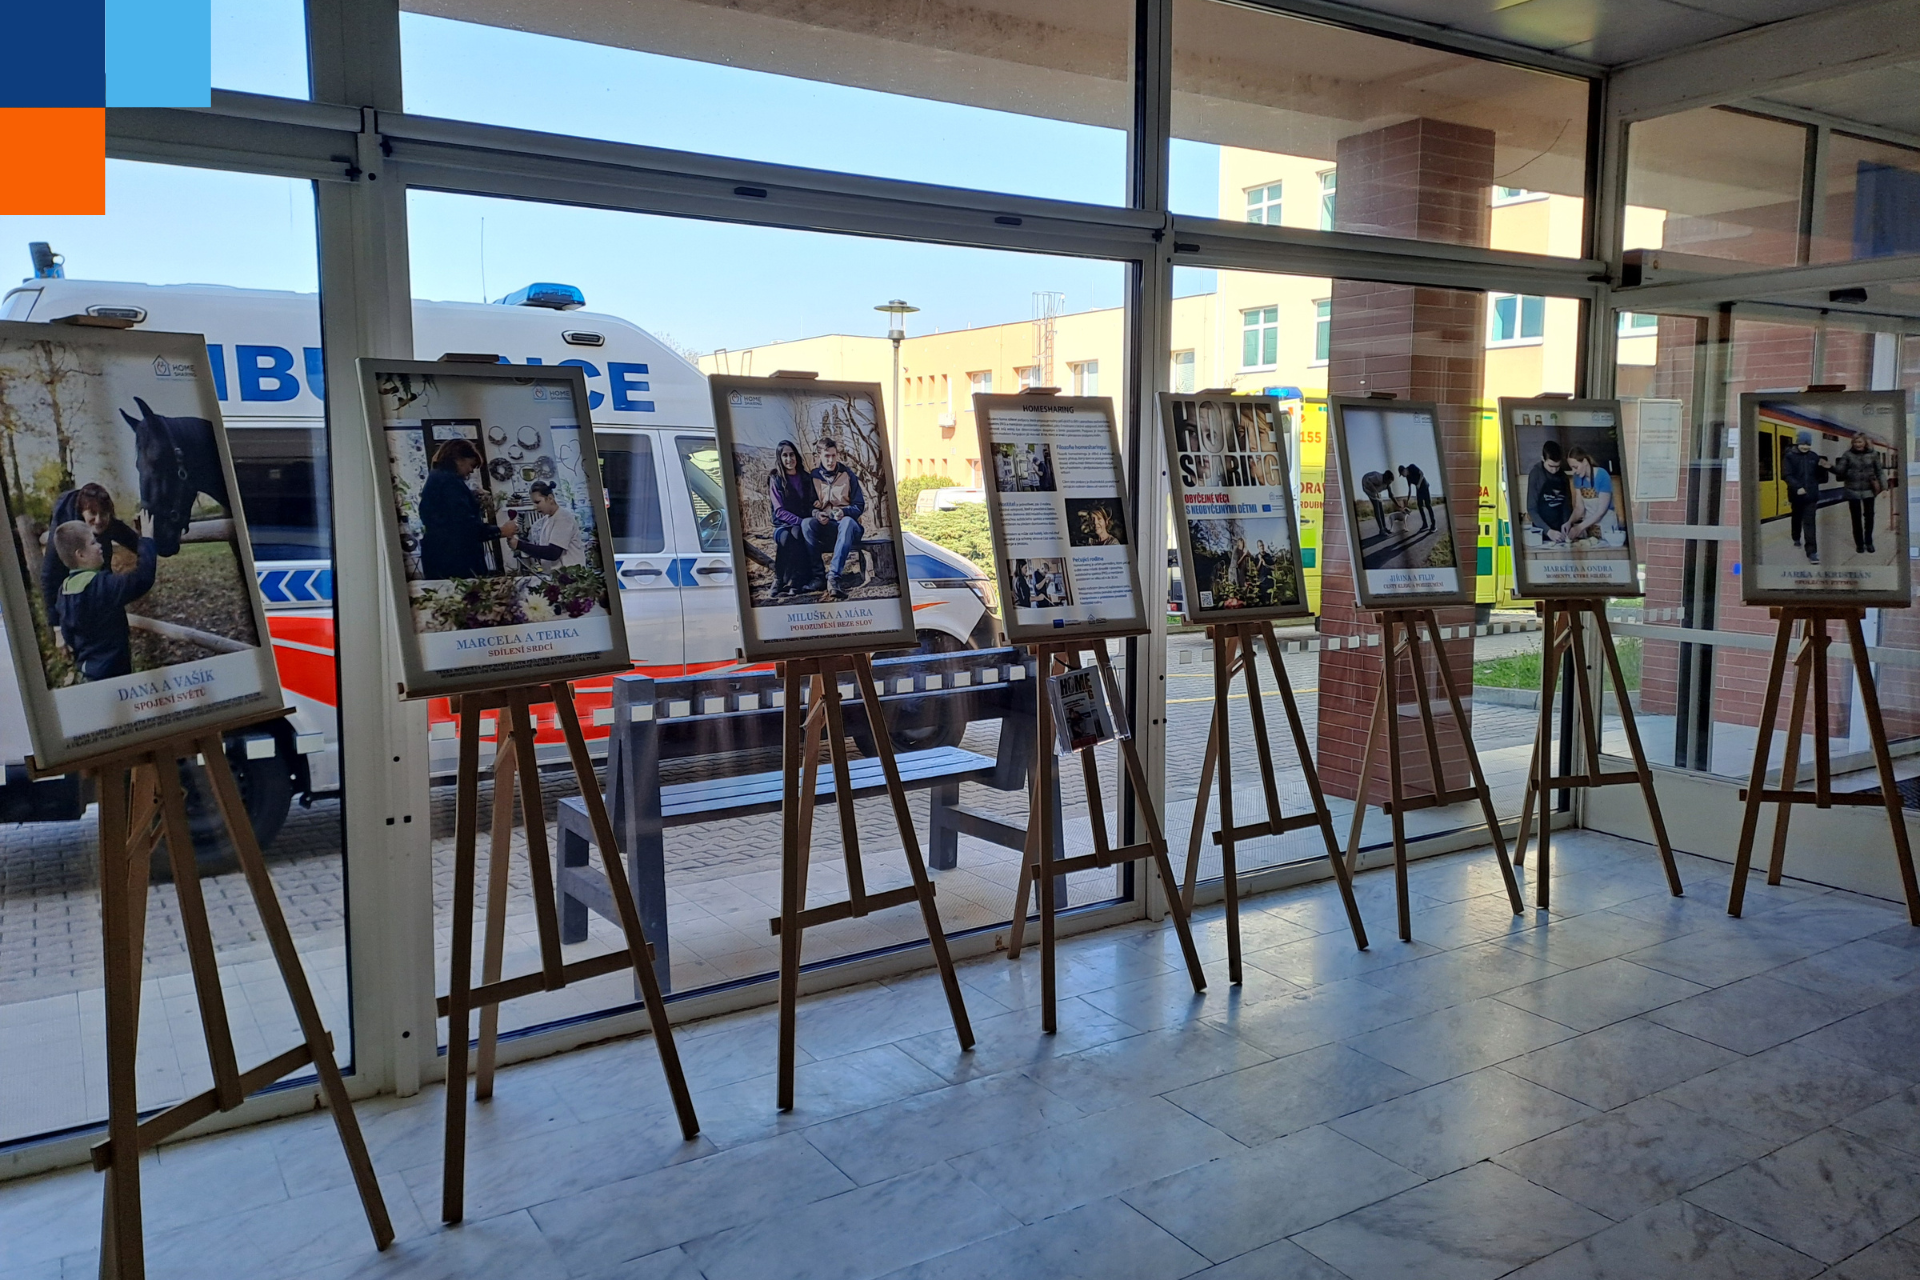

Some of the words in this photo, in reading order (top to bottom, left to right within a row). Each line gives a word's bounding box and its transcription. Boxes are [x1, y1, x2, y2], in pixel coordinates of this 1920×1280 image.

[1022, 404, 1075, 414] HOMESHARING
[1172, 400, 1279, 453] HOME
[1299, 431, 1322, 444] 155
[1179, 454, 1282, 488] SHARING
[1184, 492, 1216, 504] OBYČEJNÉ
[1185, 504, 1191, 515] S
[787, 610, 834, 623] MILUŠKA
[844, 606, 874, 618] MÁRA
[790, 621, 837, 632] POROZUMĚNÍ
[837, 620, 855, 628] BEZE
[855, 618, 873, 626] SLOV
[456, 633, 522, 650] MARCELA
[525, 632, 534, 642] A
[536, 628, 580, 641] TERKA
[488, 645, 525, 657] SDÍLENÍ
[526, 642, 554, 653] SRDCÍ
[118, 682, 158, 701] DANA
[161, 679, 172, 692] A
[173, 669, 216, 688] VAŠÍK
[133, 694, 176, 712] SPOJENÍ
[176, 687, 208, 702] SVĚTŮ
